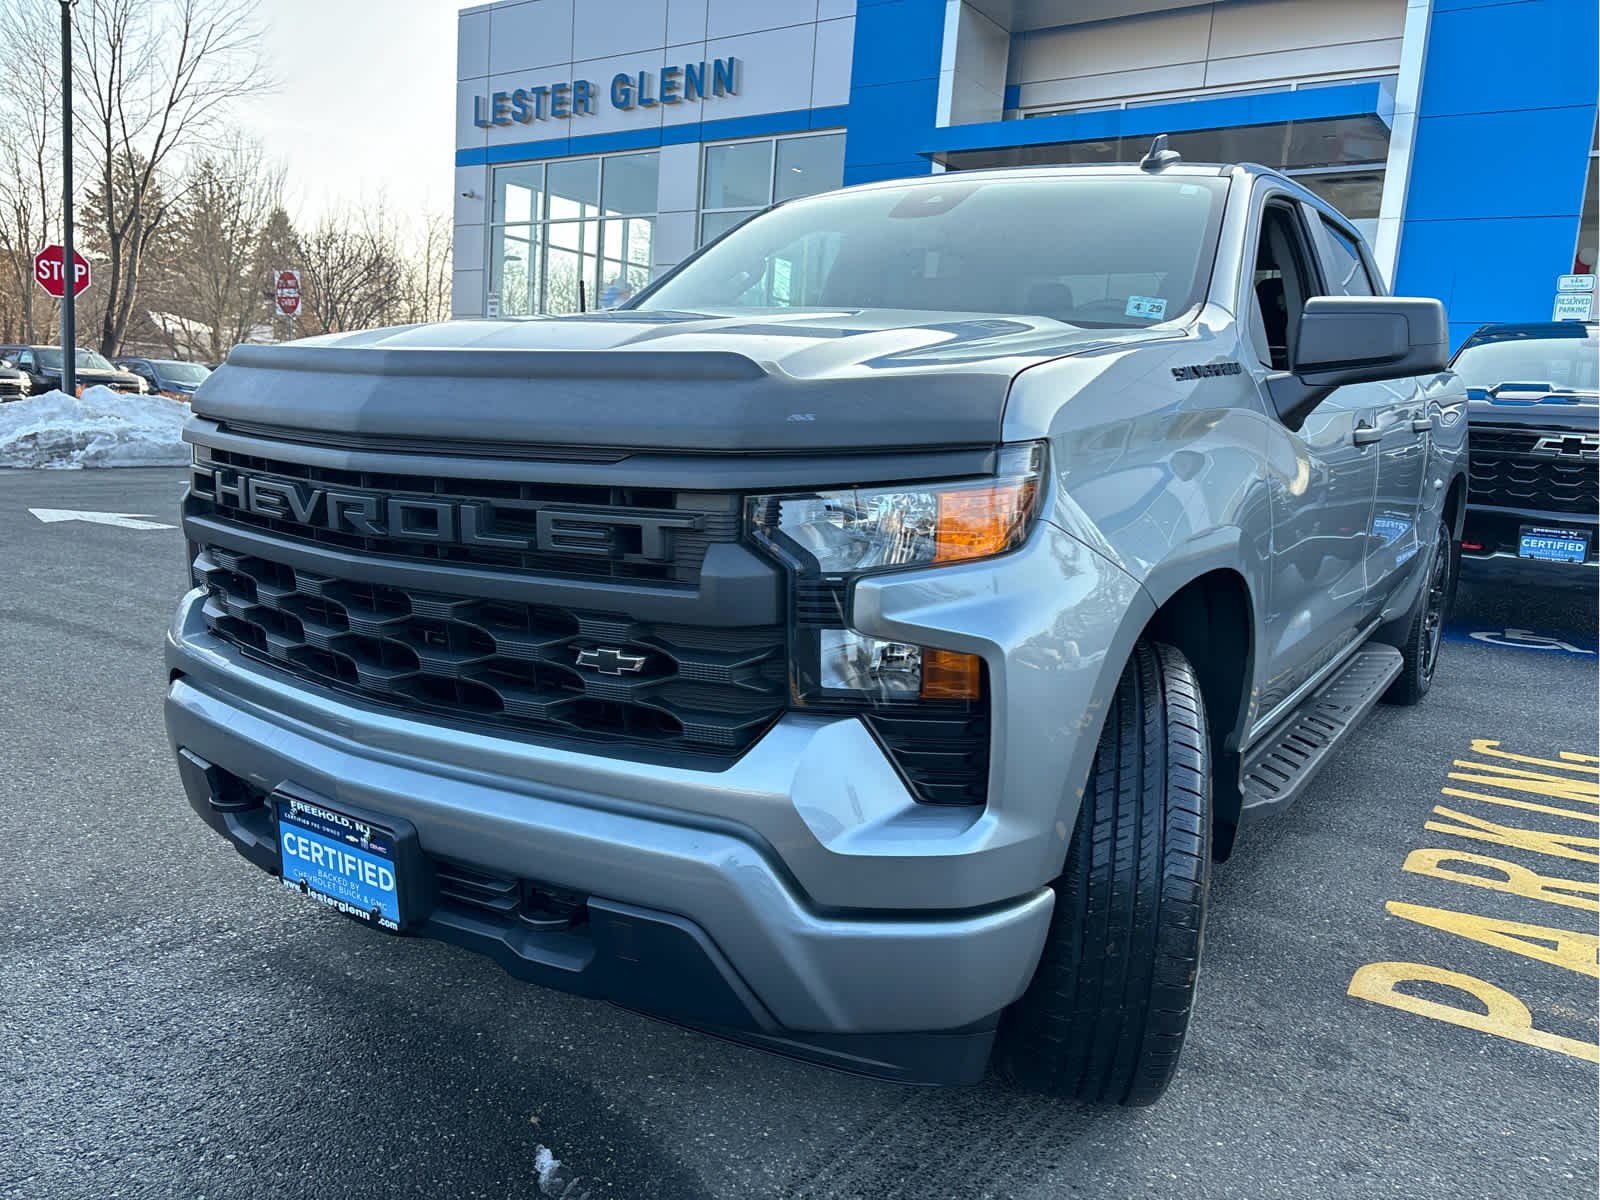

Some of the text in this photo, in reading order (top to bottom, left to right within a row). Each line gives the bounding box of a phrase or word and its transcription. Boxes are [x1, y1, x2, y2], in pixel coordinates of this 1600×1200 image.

[474, 57, 738, 127] LESTER GLENN
[1148, 304, 1162, 313] 29
[189, 463, 704, 562] CHEVROLET
[1521, 538, 1585, 552] CERTIFIED
[283, 832, 394, 891] CERTIFIED
[317, 869, 360, 890] BACKED BY
[294, 868, 388, 911] CHEVROLET BUICK & GMC
